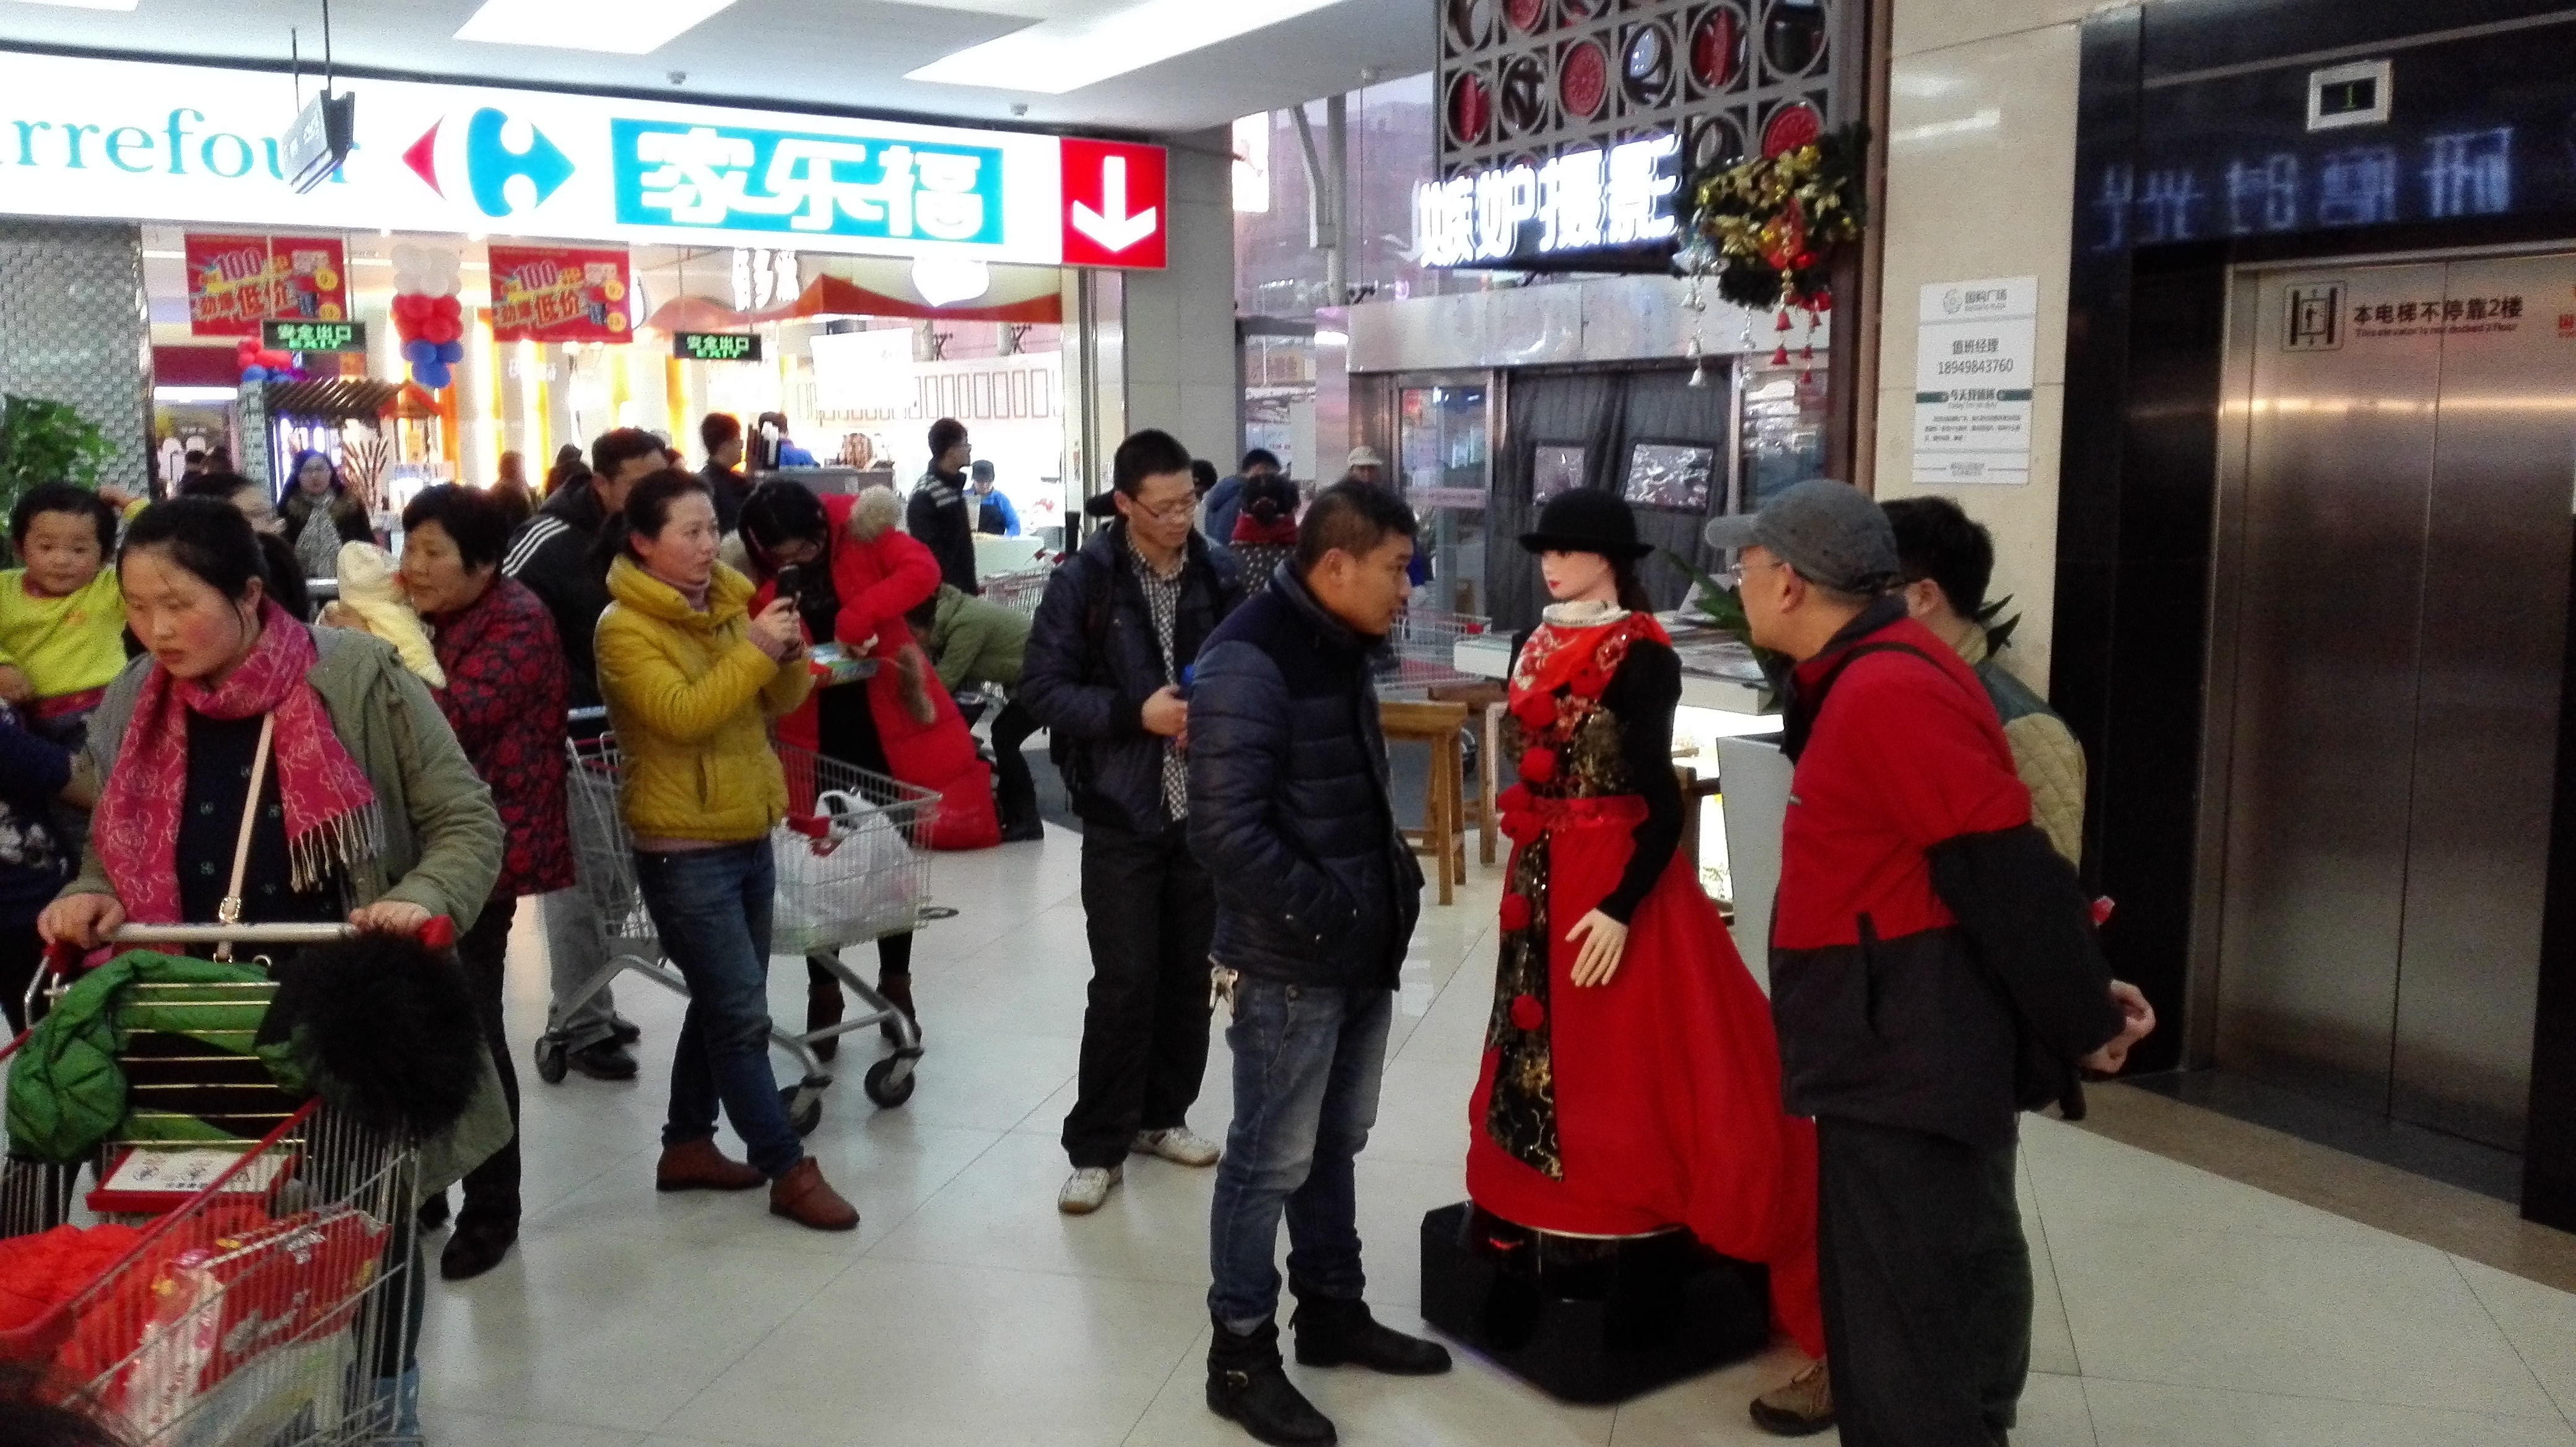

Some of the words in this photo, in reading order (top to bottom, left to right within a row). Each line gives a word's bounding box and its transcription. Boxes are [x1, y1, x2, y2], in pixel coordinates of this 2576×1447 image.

[637, 126, 983, 240] 家乐福
[2353, 295, 2523, 325] 本电梯不停靠2楼
